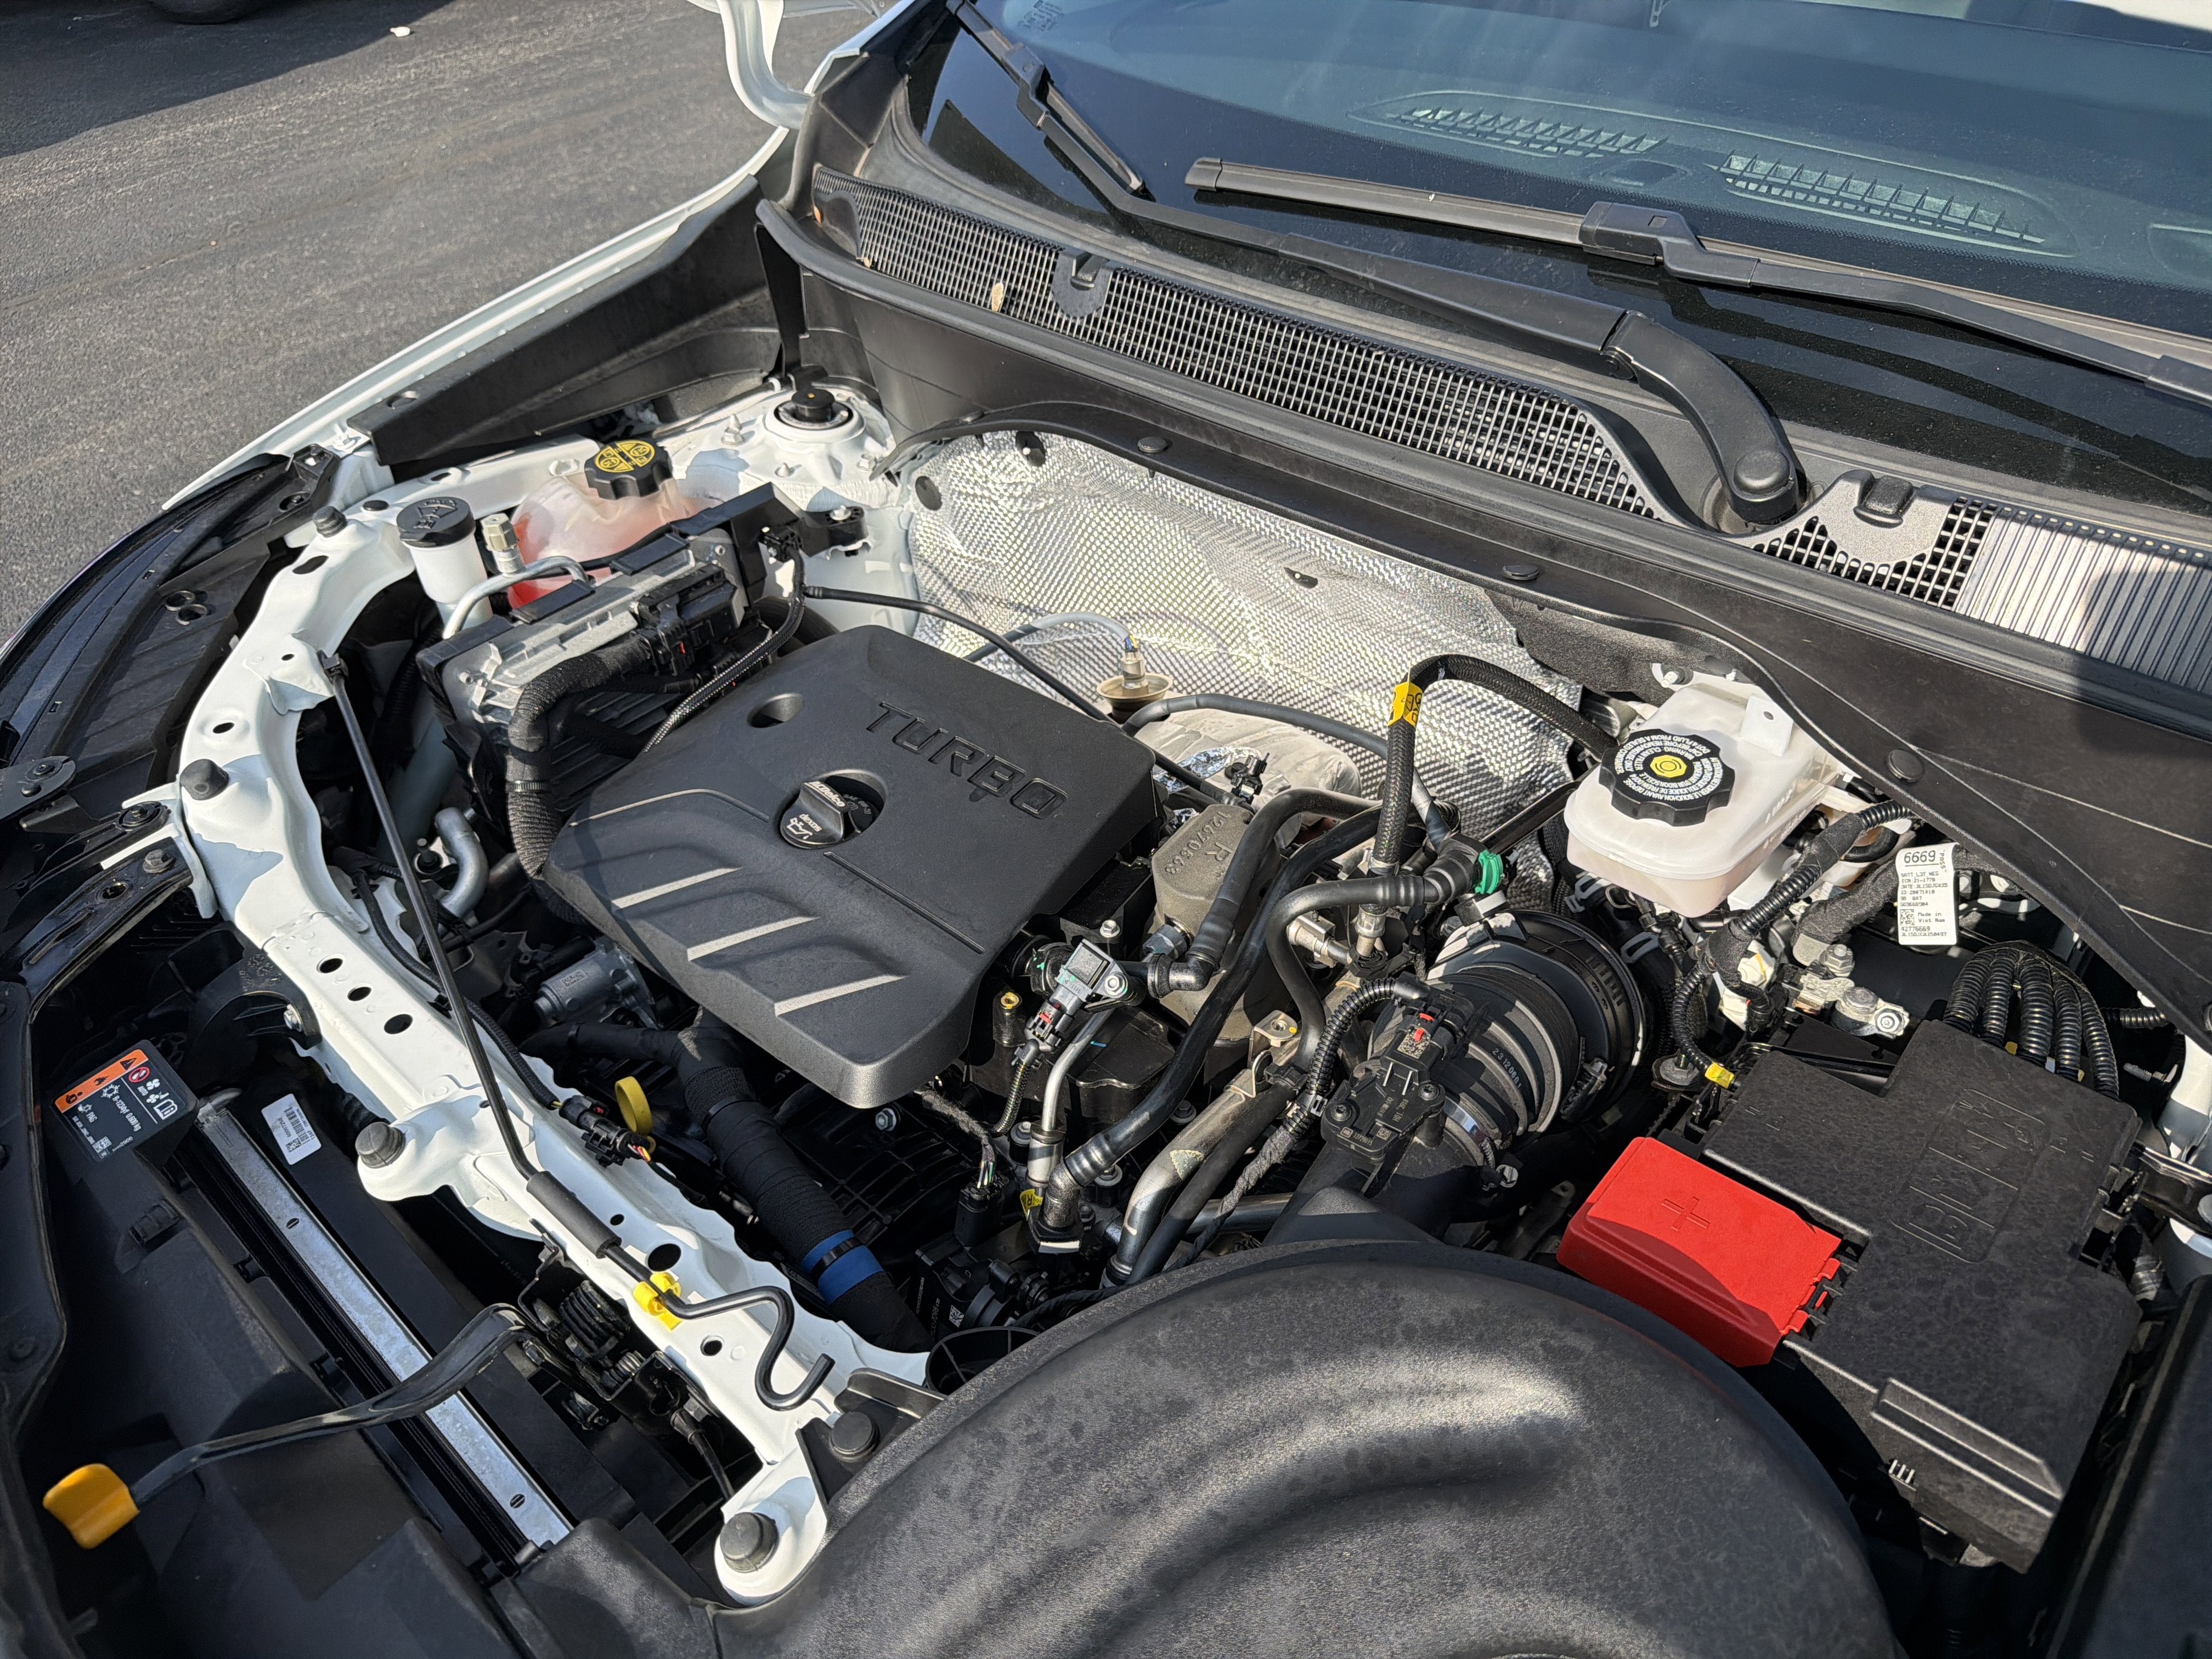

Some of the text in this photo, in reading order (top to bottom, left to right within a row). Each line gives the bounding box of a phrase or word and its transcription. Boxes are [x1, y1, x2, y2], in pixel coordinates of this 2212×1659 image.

[1621, 736, 1646, 751] SEALED
[1662, 740, 1690, 750] BEFORE
[1672, 735, 1694, 745] FLUID
[1687, 746, 1703, 757] CAP
[1695, 743, 1711, 754] DOT
[866, 701, 1068, 820] TURBO
[1634, 746, 1696, 770] WARNING: CLEAN FILLER
[1624, 759, 1634, 772] ONLY
[1640, 781, 1660, 792] FREIN
[809, 781, 845, 807] ACDelco
[1642, 789, 1663, 799] AVANT
[858, 800, 872, 815] 0W-20
[799, 814, 822, 832] dexos
[1904, 850, 1936, 864] 6669
[137, 1086, 148, 1096] AUTO
[86, 1112, 98, 1123] PAG
[112, 1096, 142, 1132] R-1234yf 0.600 kg
